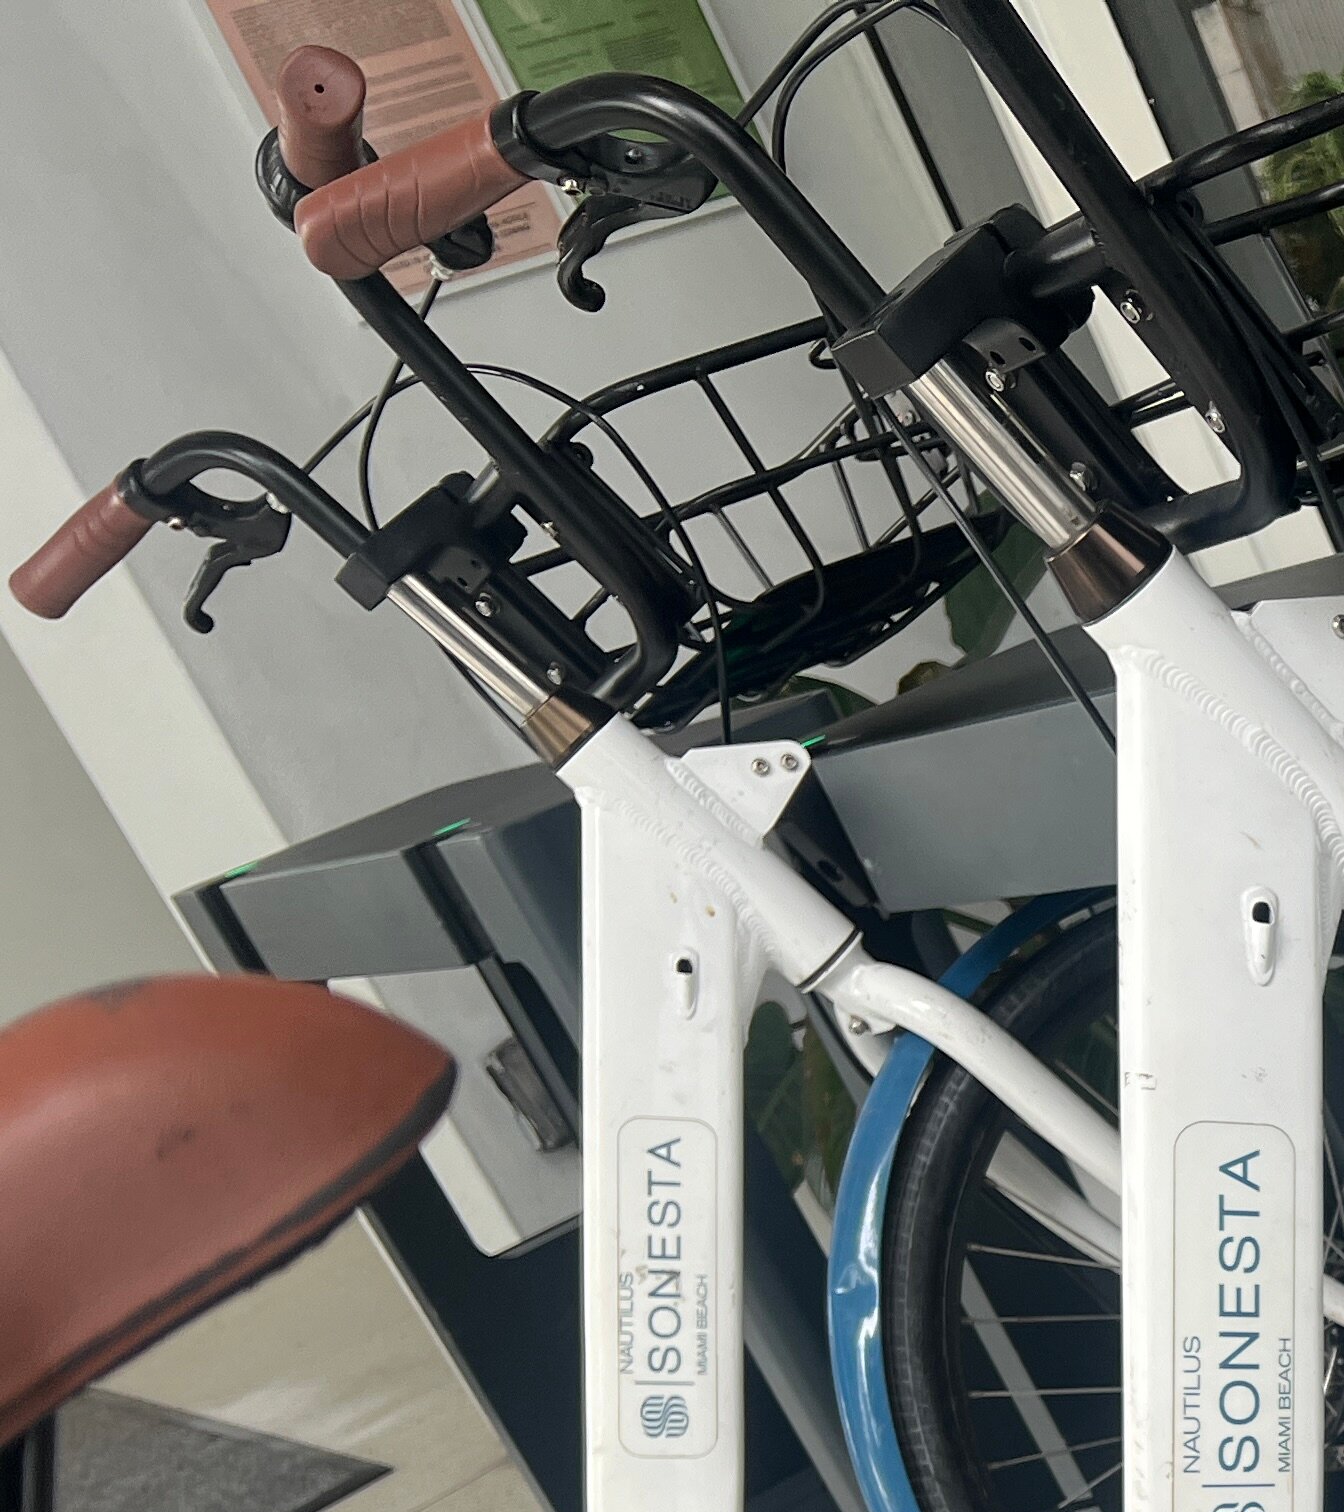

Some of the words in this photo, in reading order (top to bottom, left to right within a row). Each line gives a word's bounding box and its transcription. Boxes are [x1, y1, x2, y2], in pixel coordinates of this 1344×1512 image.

[646, 1137, 682, 1375] SONESTA
[619, 1271, 635, 1376] NAUTILUS
[696, 1273, 709, 1329] BEACH
[1218, 1149, 1261, 1473] SONESTA
[696, 1331, 708, 1376] MIAMI
[1278, 1337, 1293, 1411] BEACH
[1183, 1336, 1202, 1474] NAUTILUS
[1278, 1414, 1293, 1474] MIAMI
